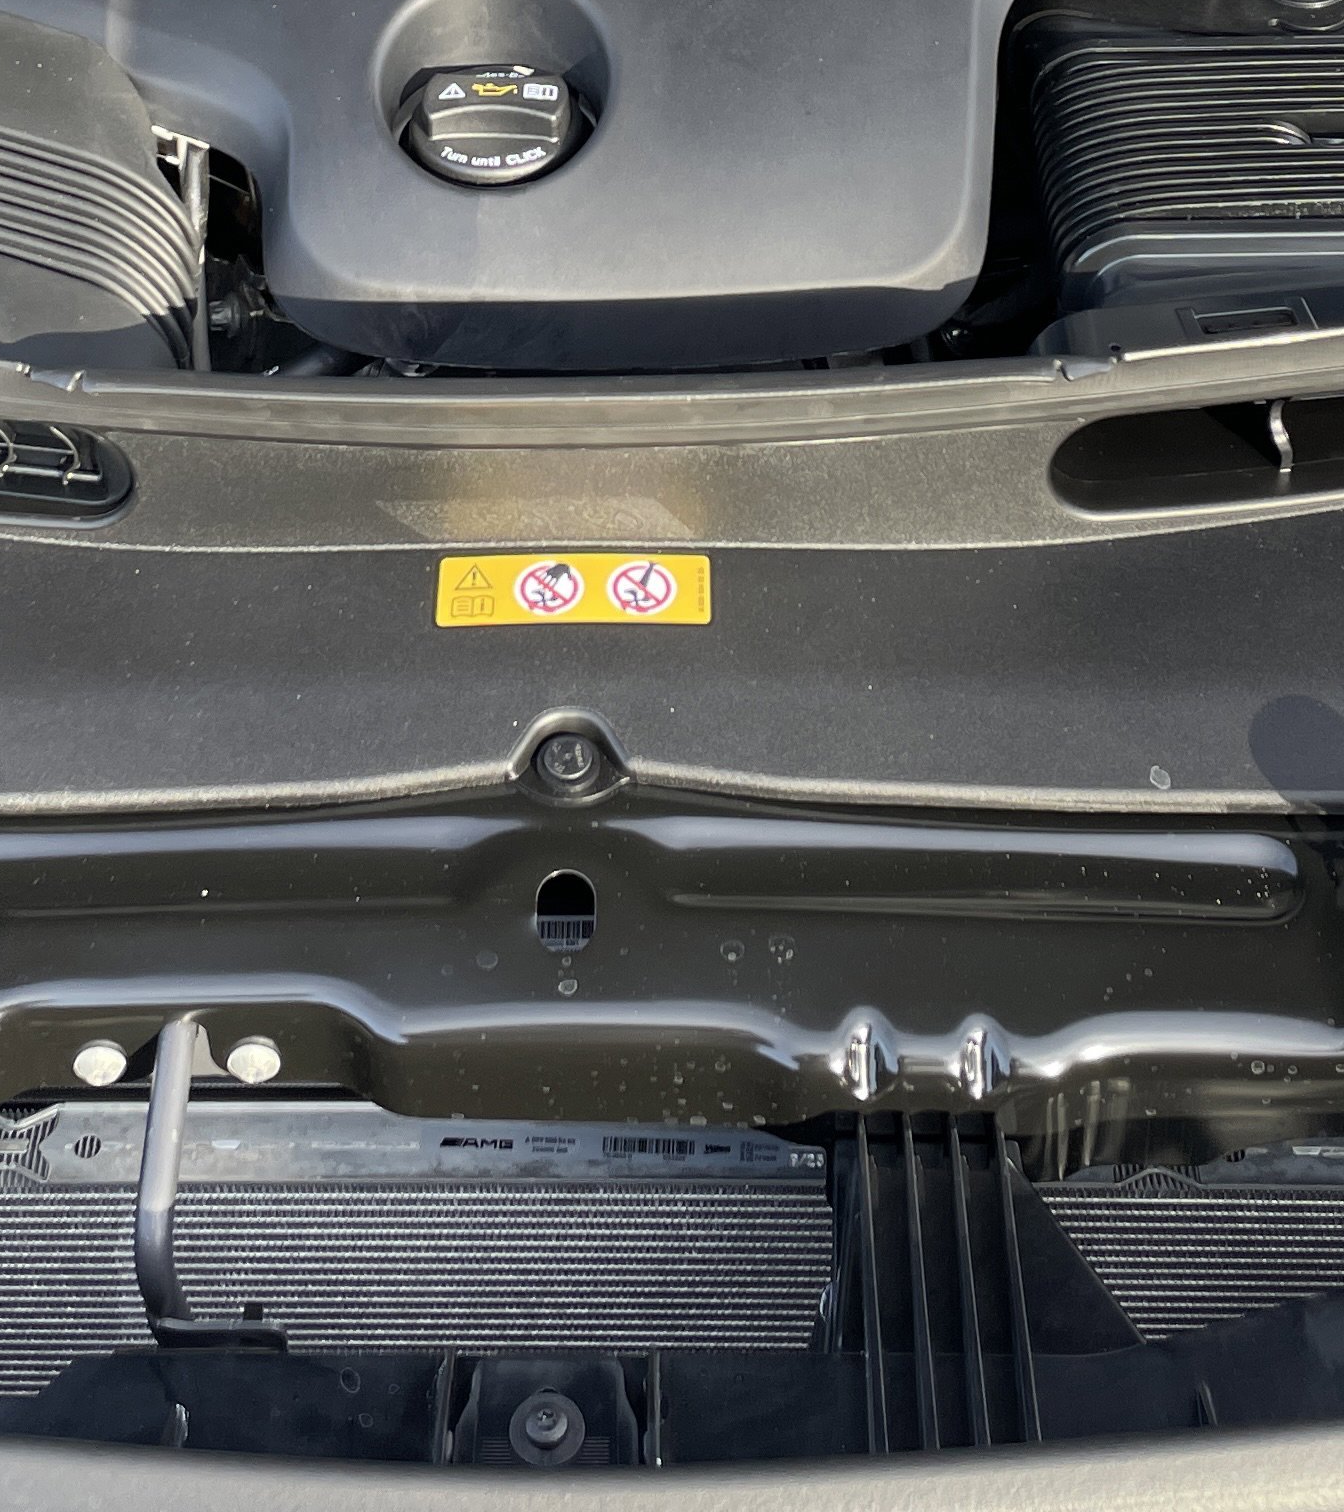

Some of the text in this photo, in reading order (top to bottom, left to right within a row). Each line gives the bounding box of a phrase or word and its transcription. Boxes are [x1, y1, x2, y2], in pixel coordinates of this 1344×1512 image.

[440, 146, 546, 167] Turn until CLICK
[462, 1137, 514, 1150] AMG
